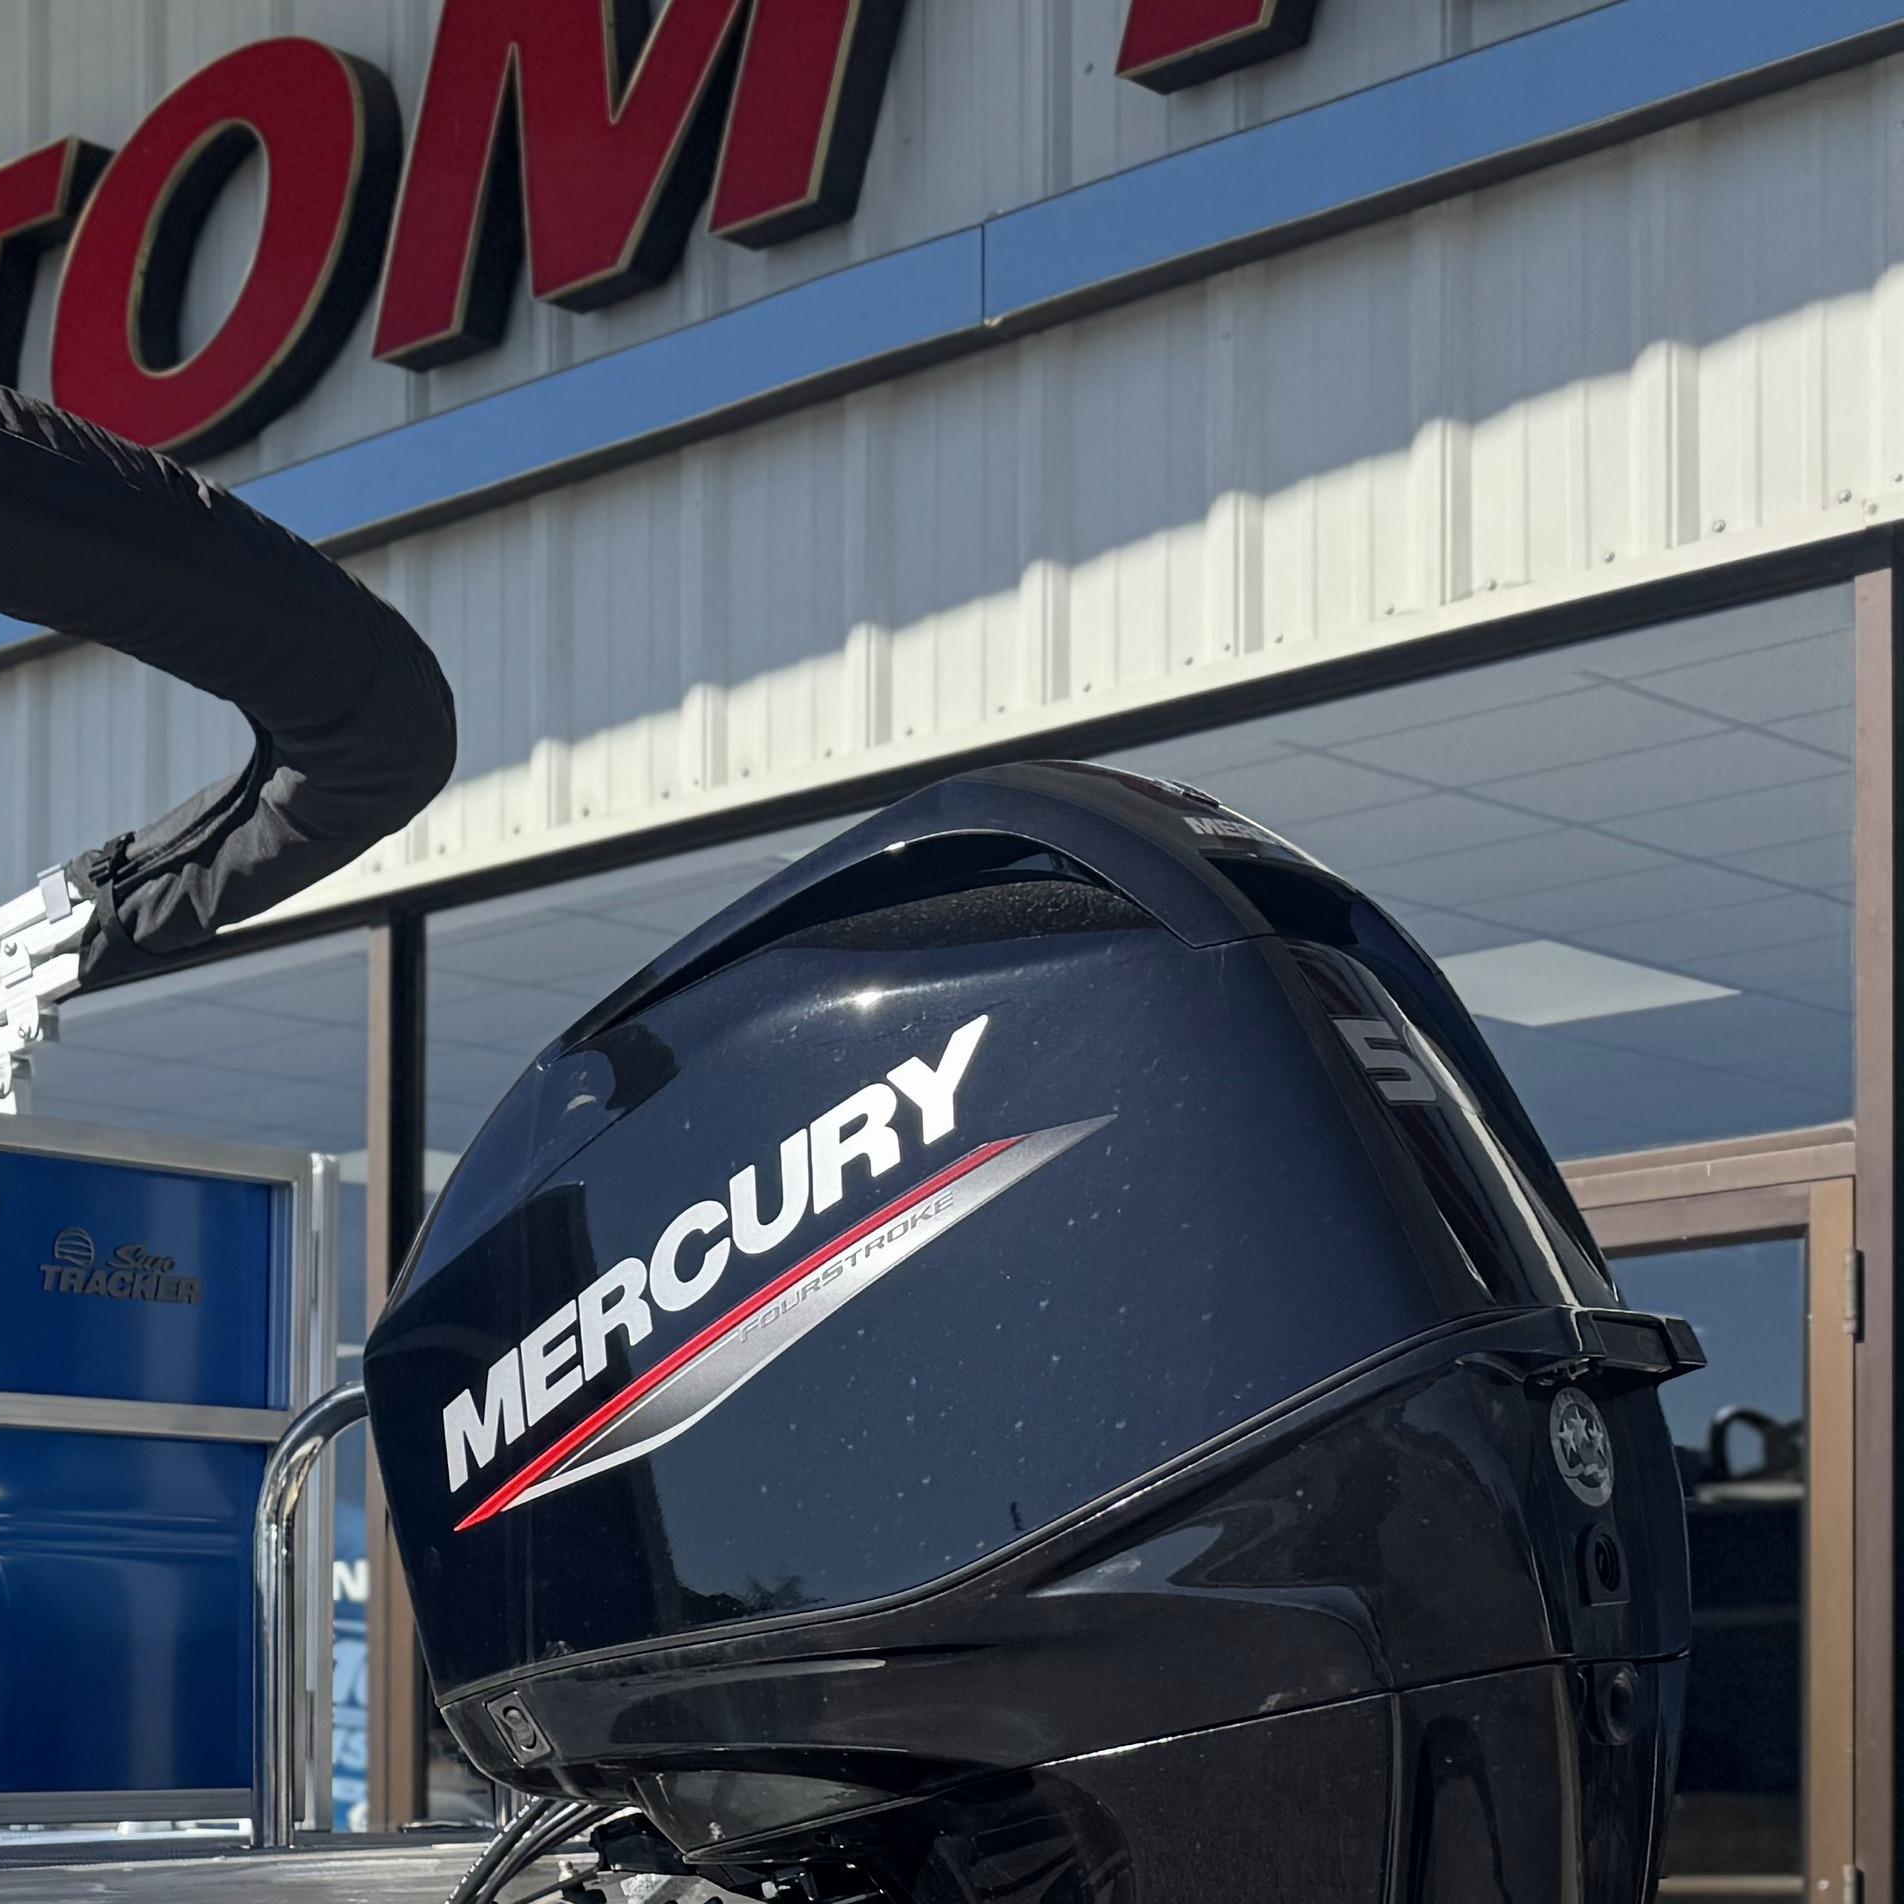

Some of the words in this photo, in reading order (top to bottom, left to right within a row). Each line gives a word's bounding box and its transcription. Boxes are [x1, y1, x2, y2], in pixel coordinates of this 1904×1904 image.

[39, 1263, 204, 1305] TRACKER
[442, 1013, 990, 1493] MERCURY
[738, 1188, 954, 1344] FOURSTROKE
